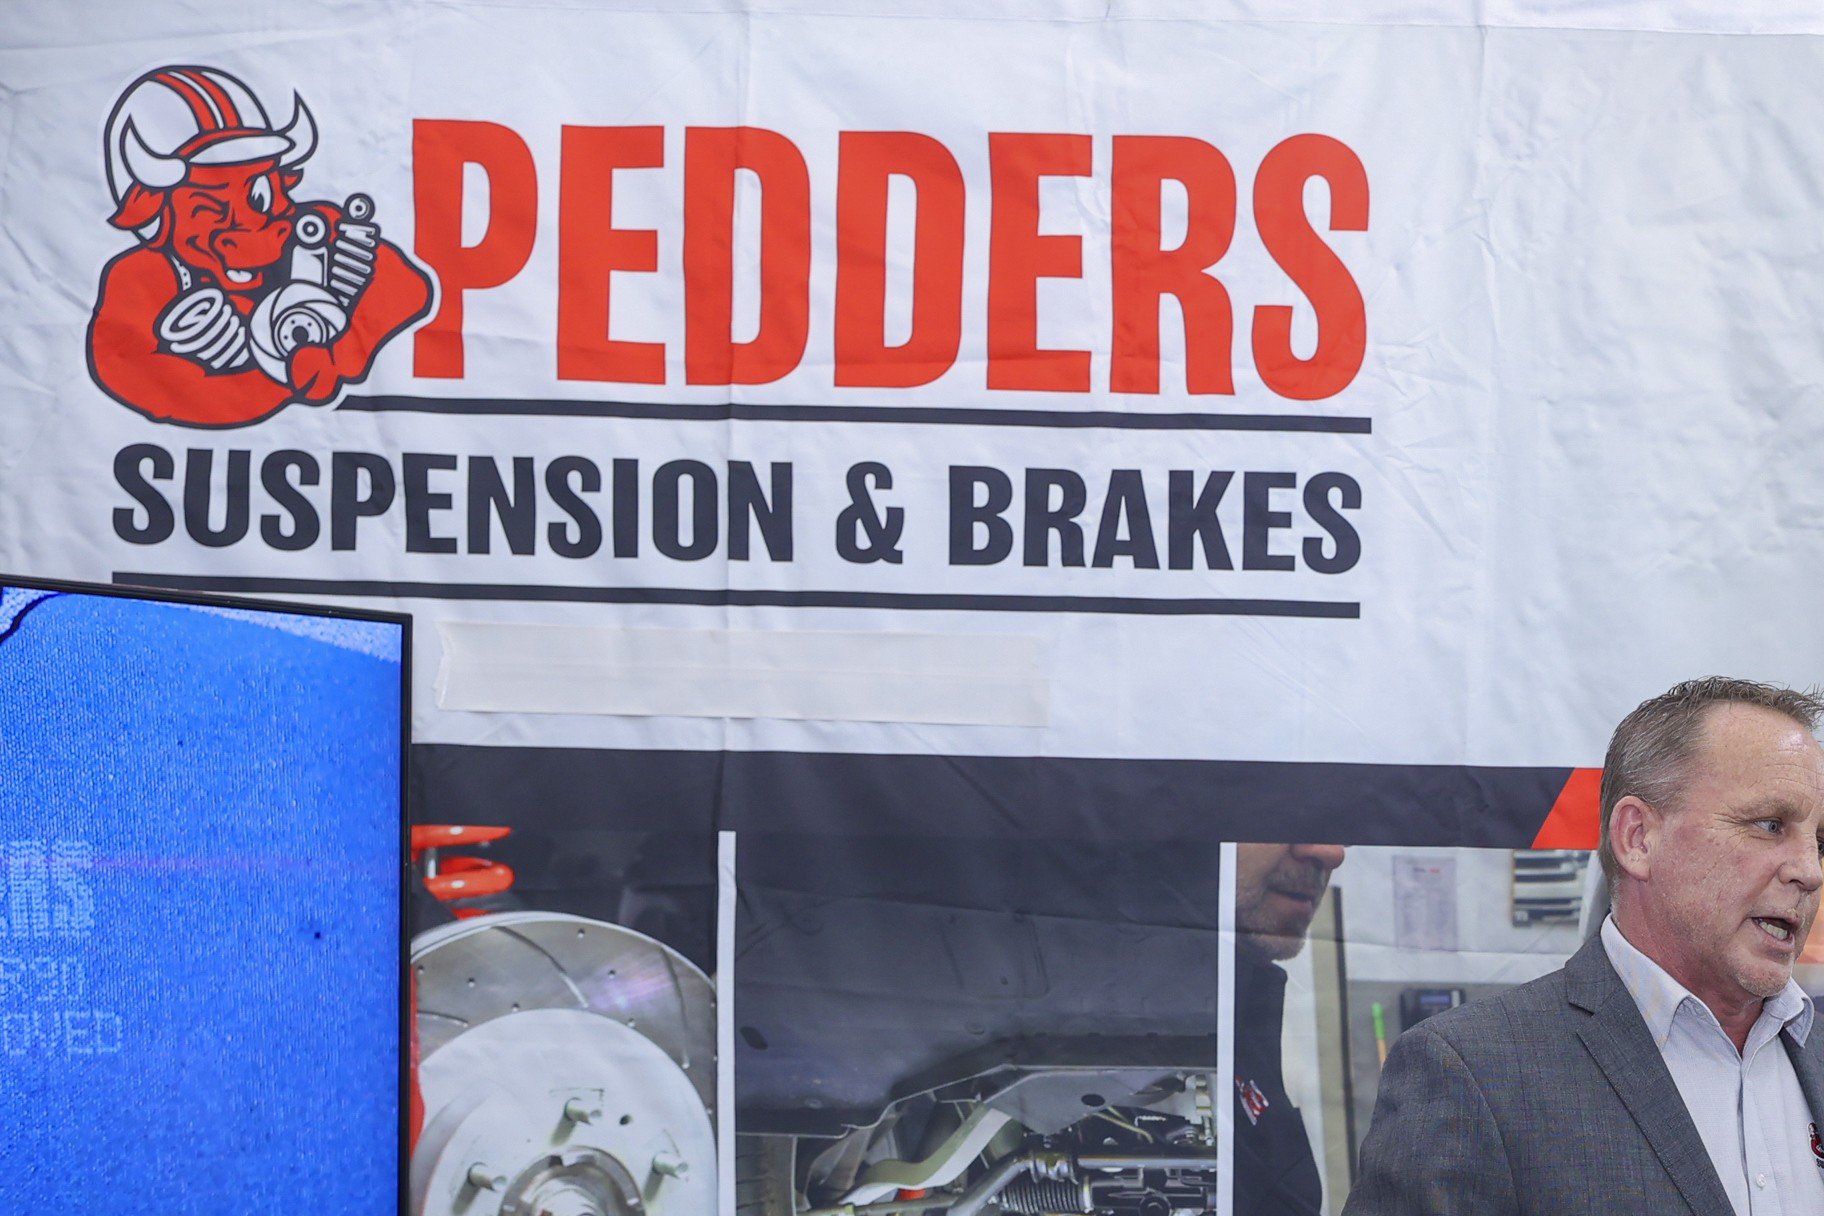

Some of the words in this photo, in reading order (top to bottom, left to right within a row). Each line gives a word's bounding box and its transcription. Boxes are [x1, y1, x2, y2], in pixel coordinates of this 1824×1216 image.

[411, 117, 1370, 401] PEDDERS
[111, 442, 794, 565] SUSPENSION
[835, 460, 905, 564] &
[948, 466, 1363, 575] BRAKES
